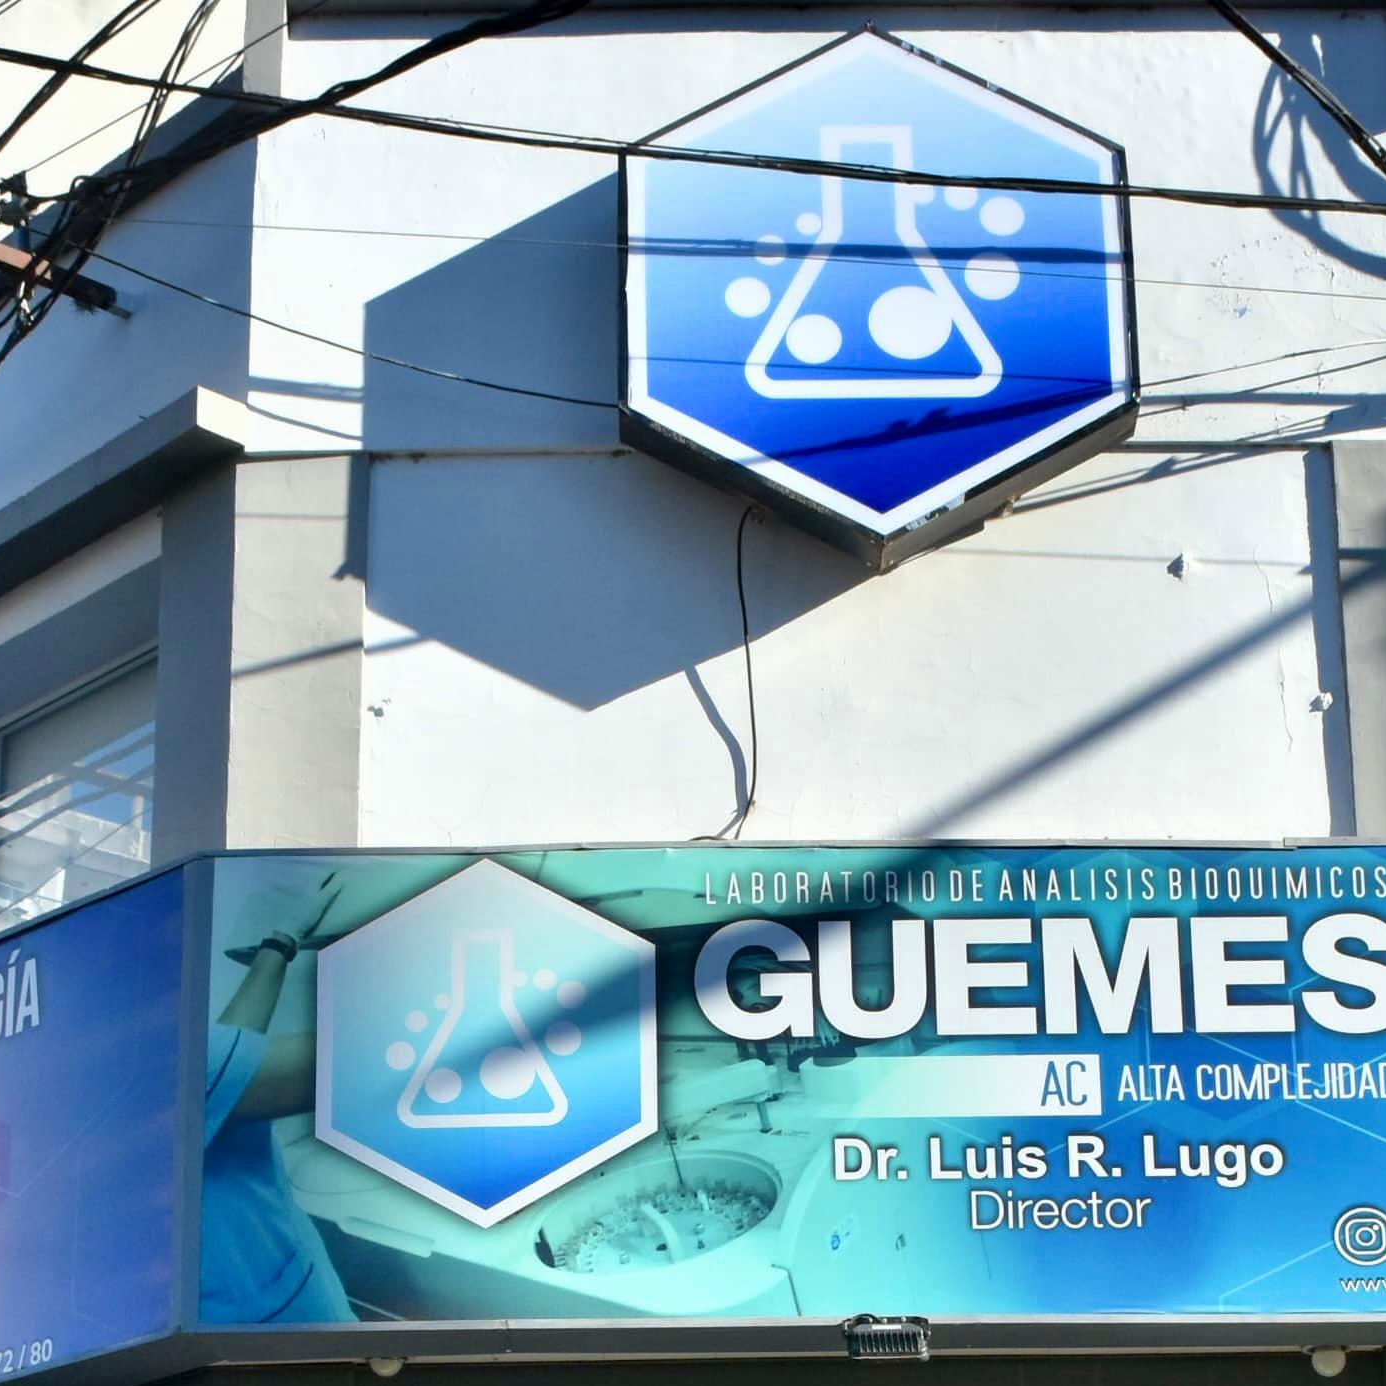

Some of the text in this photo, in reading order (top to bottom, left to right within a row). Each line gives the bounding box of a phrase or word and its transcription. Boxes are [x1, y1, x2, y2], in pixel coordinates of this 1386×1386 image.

[705, 870, 935, 904] LABORATORIO
[949, 869, 983, 902] DE
[998, 867, 1154, 902] ANALISIS
[1041, 1060, 1088, 1107] AC
[1118, 1064, 1185, 1101] ALTA
[832, 1134, 1284, 1188] Dr. Luis R. Lugo
[970, 1191, 1151, 1231] Director
[30, 1338, 53, 1366] 80
